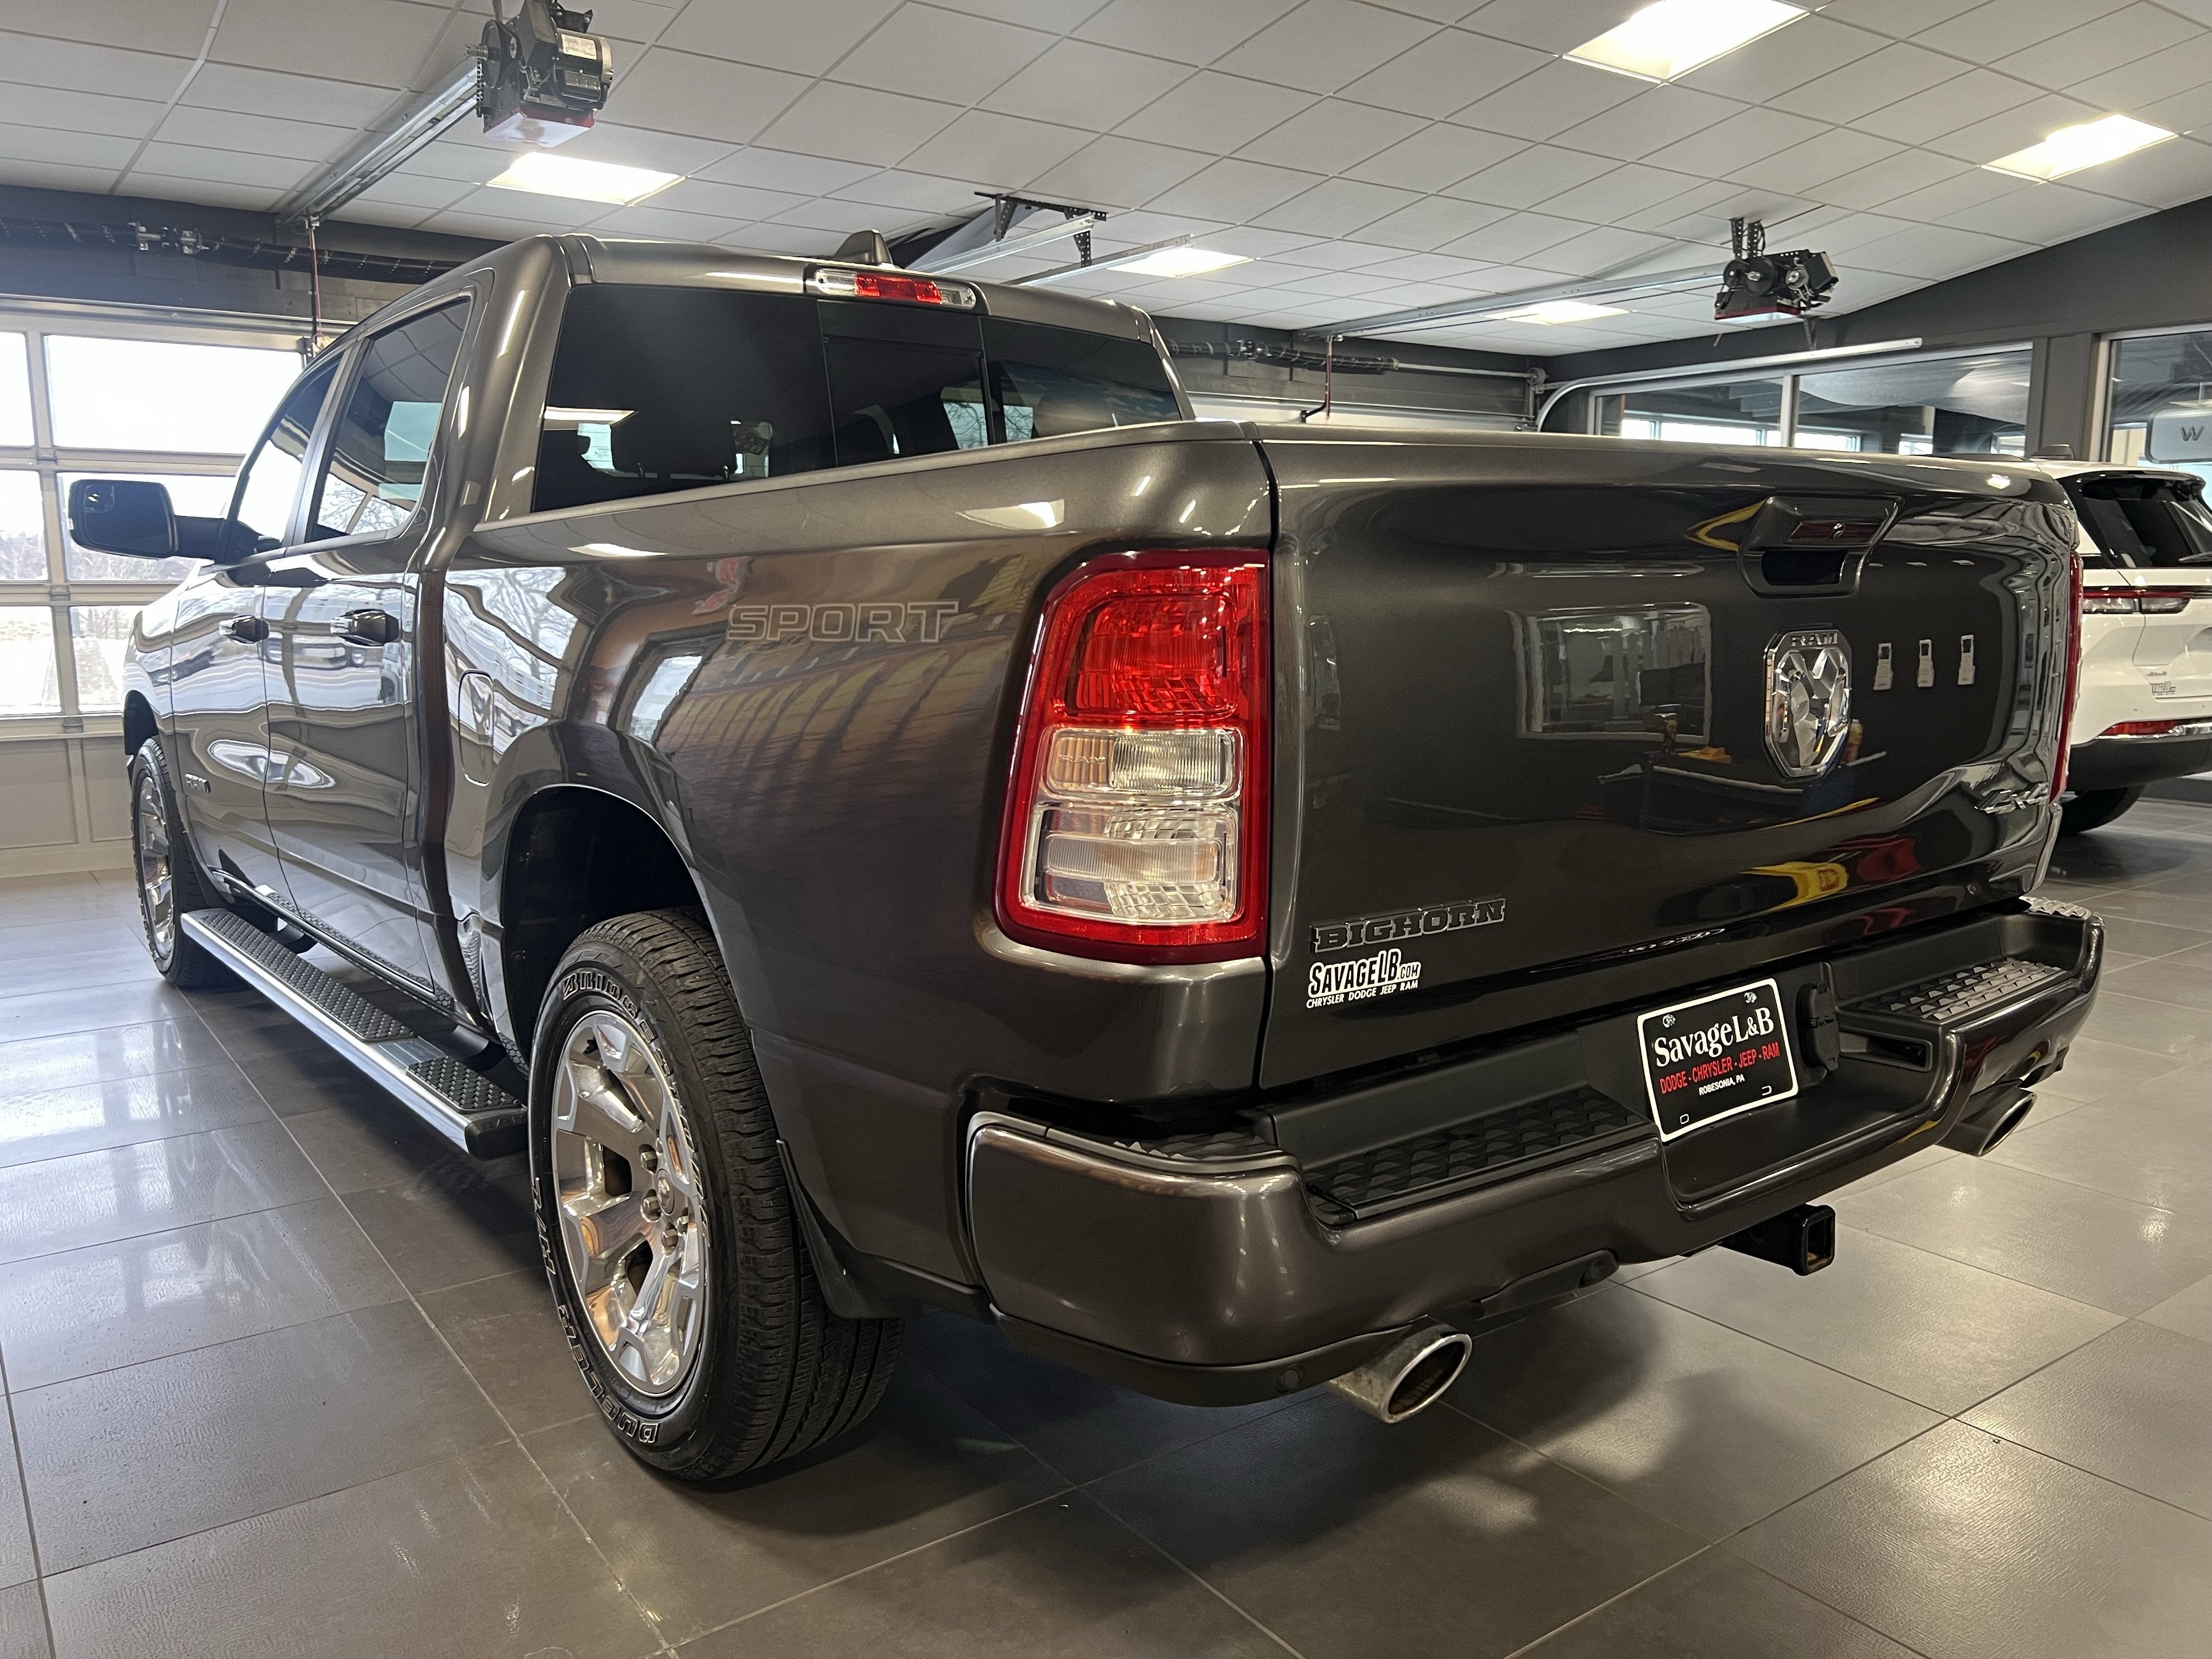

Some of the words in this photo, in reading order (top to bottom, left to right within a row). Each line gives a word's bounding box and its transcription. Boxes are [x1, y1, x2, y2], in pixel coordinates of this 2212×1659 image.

[727, 600, 959, 643] SPORT
[1790, 633, 1838, 647] RAM
[1310, 897, 1506, 953] BIGHORN
[1306, 994, 1344, 1009] CHRYSLER
[1348, 987, 1376, 1001] DODGE
[1380, 984, 1397, 995] JEEP
[1400, 979, 1418, 991] RAM
[1654, 1007, 1774, 1067] SavageL&B
[1659, 1071, 1688, 1094] DODGE
[1692, 1056, 1733, 1083] CHRYSLER
[1739, 1048, 1757, 1068] JEEP
[1762, 1042, 1780, 1060] RAM
[1699, 1077, 1735, 1096] ROBESONIA,
[1736, 1074, 1745, 1084] PA
[557, 1303, 659, 1446] DUELER
